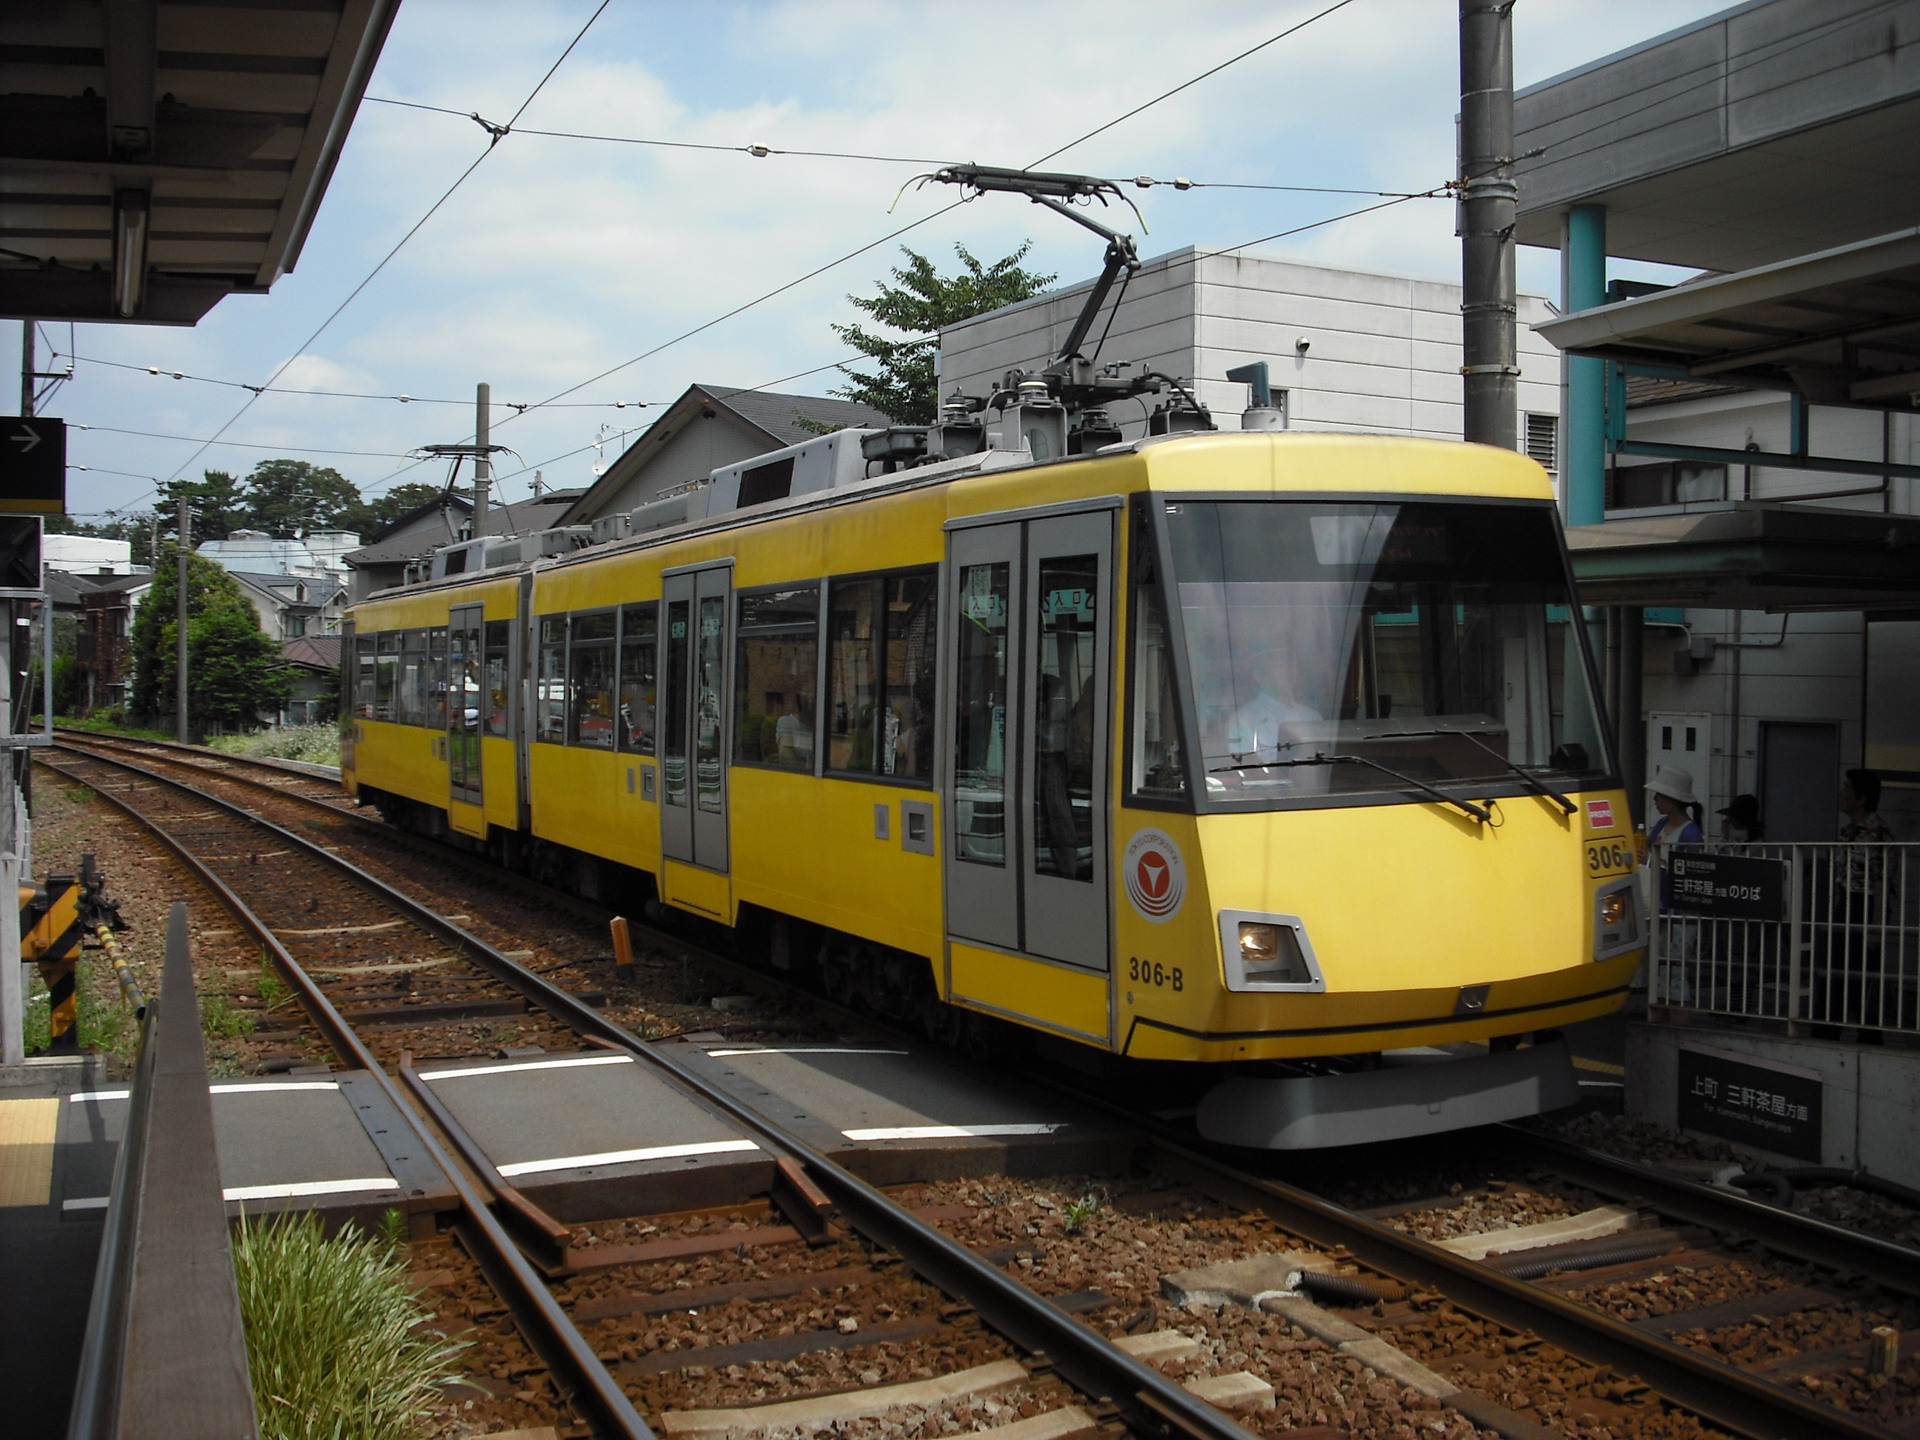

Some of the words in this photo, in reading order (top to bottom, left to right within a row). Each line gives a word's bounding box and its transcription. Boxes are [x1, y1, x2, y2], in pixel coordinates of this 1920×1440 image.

[1054, 591, 1081, 607] 入口
[1588, 844, 1622, 871] 306
[1129, 956, 1183, 992] 306-B
[1690, 1074, 1719, 1099] 上町
[1726, 1084, 1809, 1121] 三軒茶屋方面
